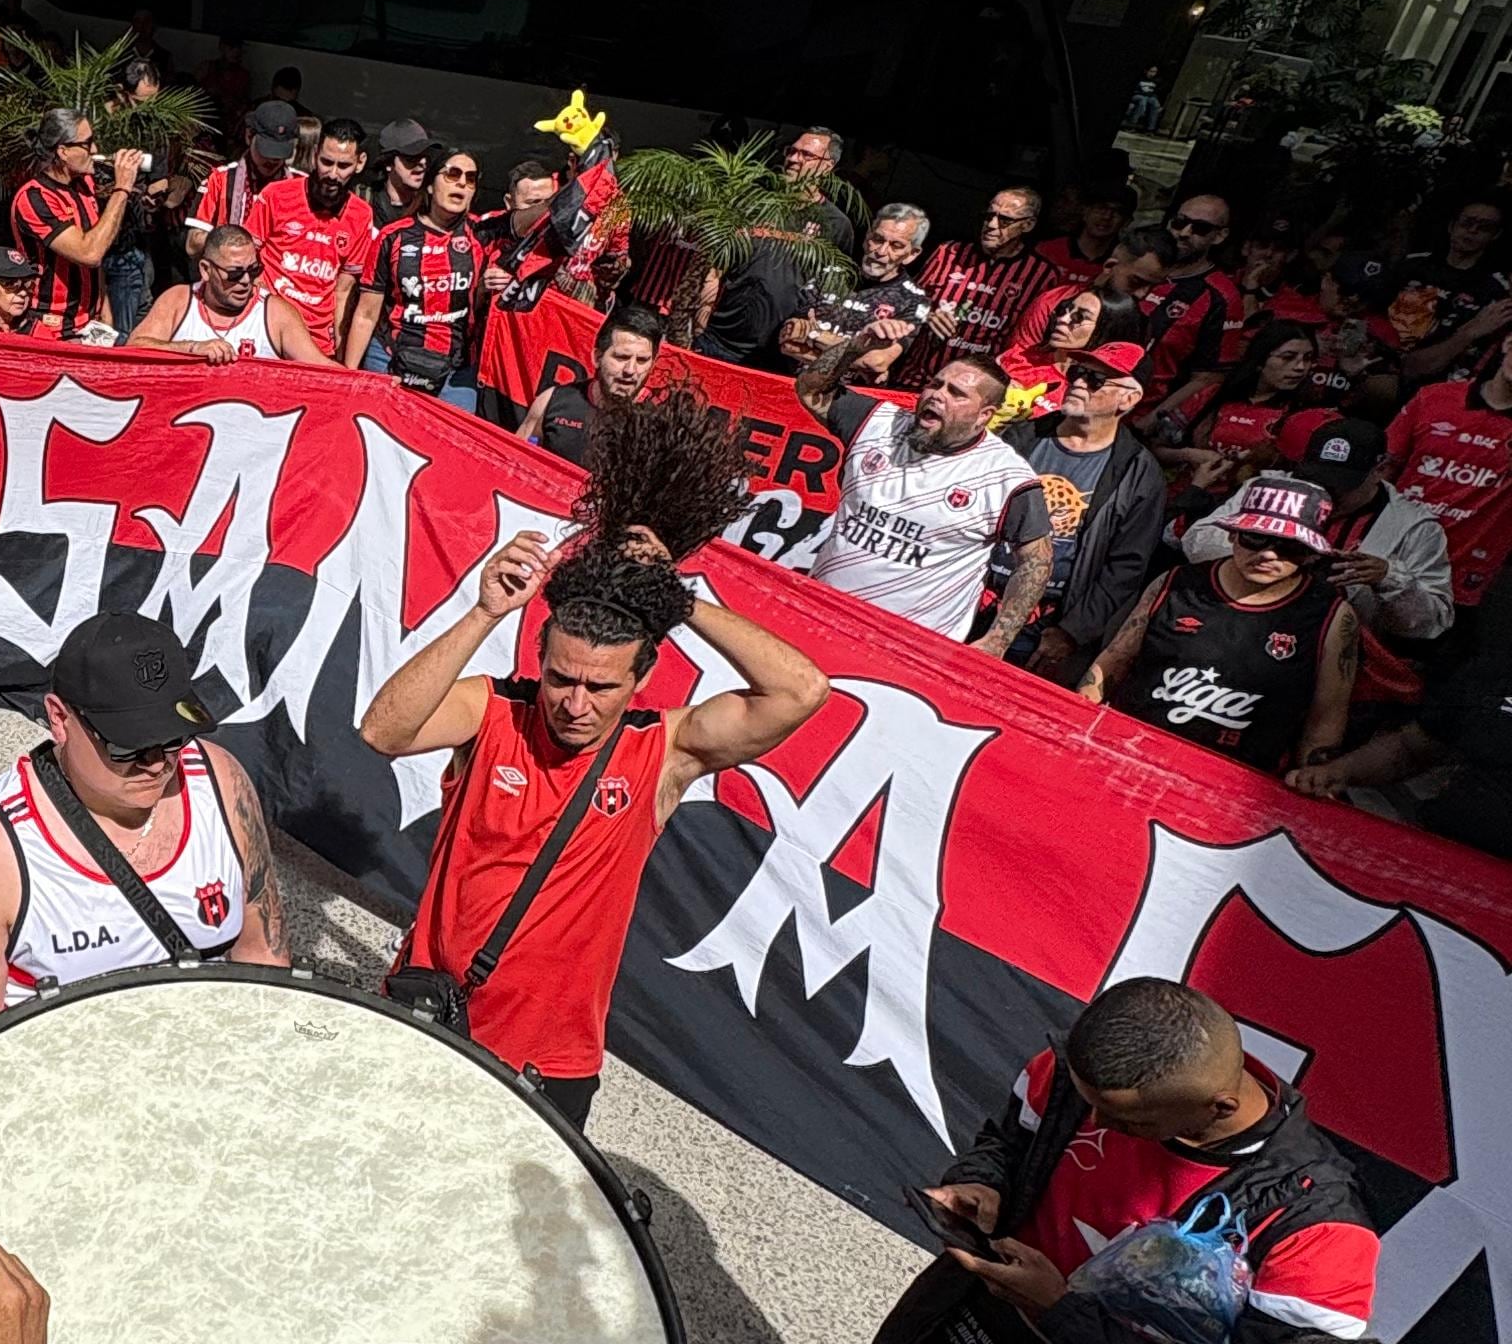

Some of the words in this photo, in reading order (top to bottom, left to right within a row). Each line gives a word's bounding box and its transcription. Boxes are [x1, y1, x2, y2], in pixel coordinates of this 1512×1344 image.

[424, 271, 473, 293] kölbi
[960, 307, 1009, 331] ölbi
[1472, 435, 1500, 449] BAC
[857, 501, 890, 529] LOS
[891, 516, 928, 544] DEL
[841, 515, 933, 569] FORTIN
[1152, 666, 1265, 730] Liga
[51, 925, 120, 954] L.D.A.
